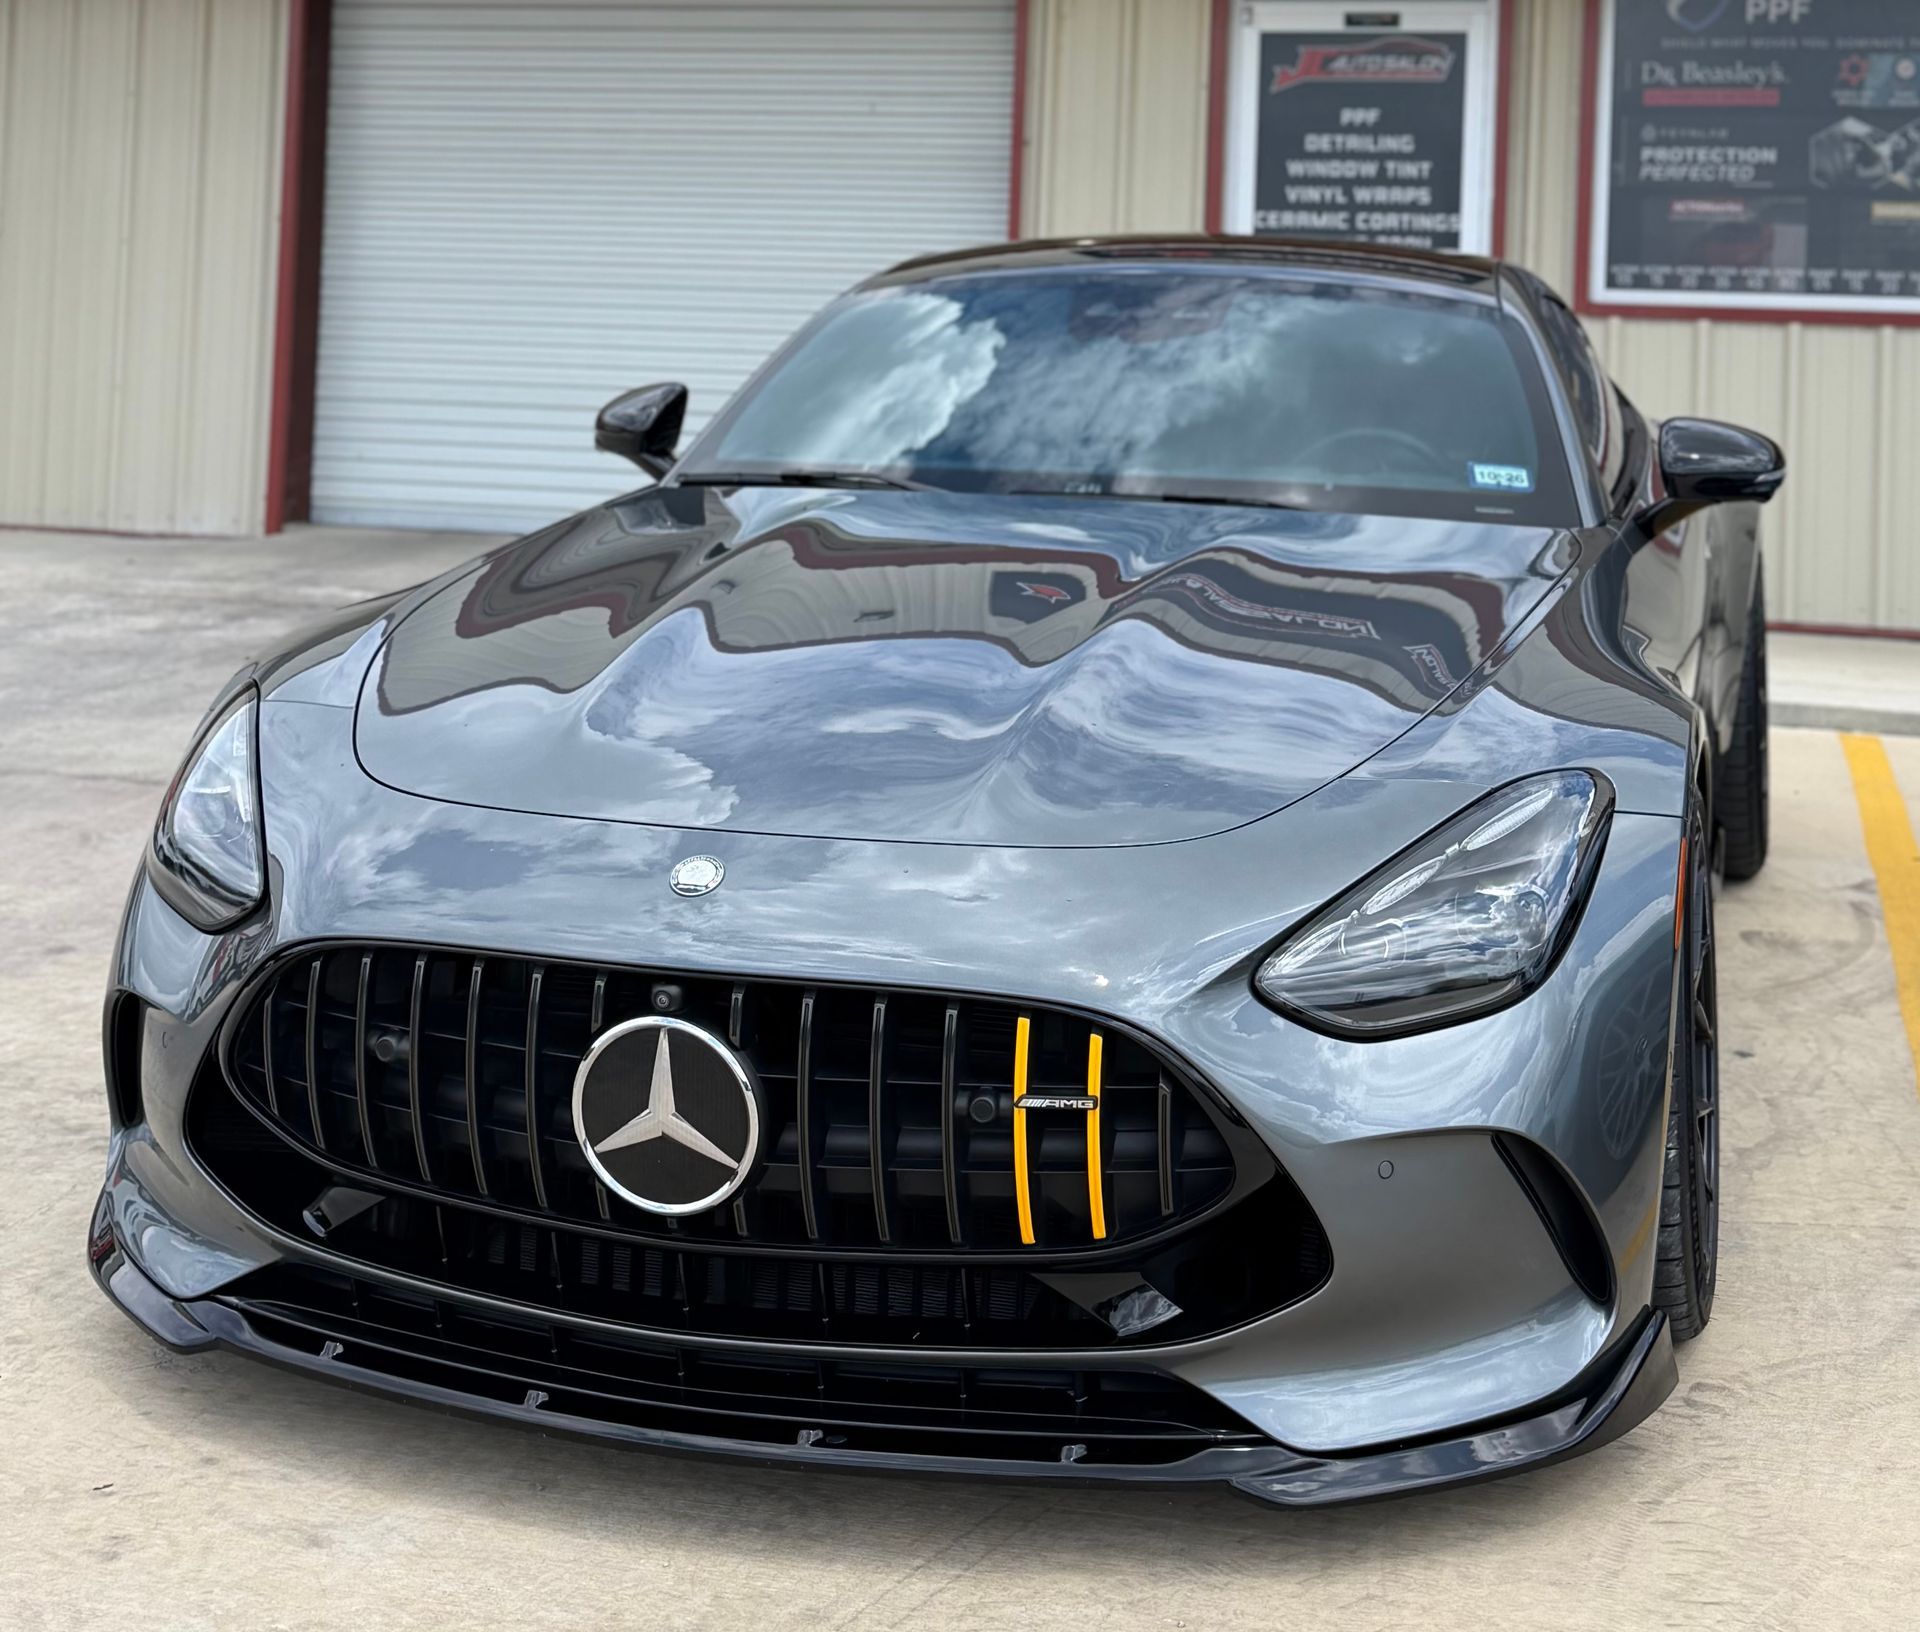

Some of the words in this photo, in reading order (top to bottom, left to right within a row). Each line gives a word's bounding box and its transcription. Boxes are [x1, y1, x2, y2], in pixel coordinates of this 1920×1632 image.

[1340, 108, 1381, 126] PPF
[1304, 133, 1415, 153] DETAILING
[1640, 146, 1778, 165] PROTECTION
[1286, 160, 1379, 178] WINDOW
[1386, 161, 1433, 179] TINT
[1639, 164, 1756, 182] PERFECTED
[1285, 186, 1348, 204] VINYL
[1353, 187, 1432, 205] WRAPS
[1255, 210, 1349, 230] CERAMIC
